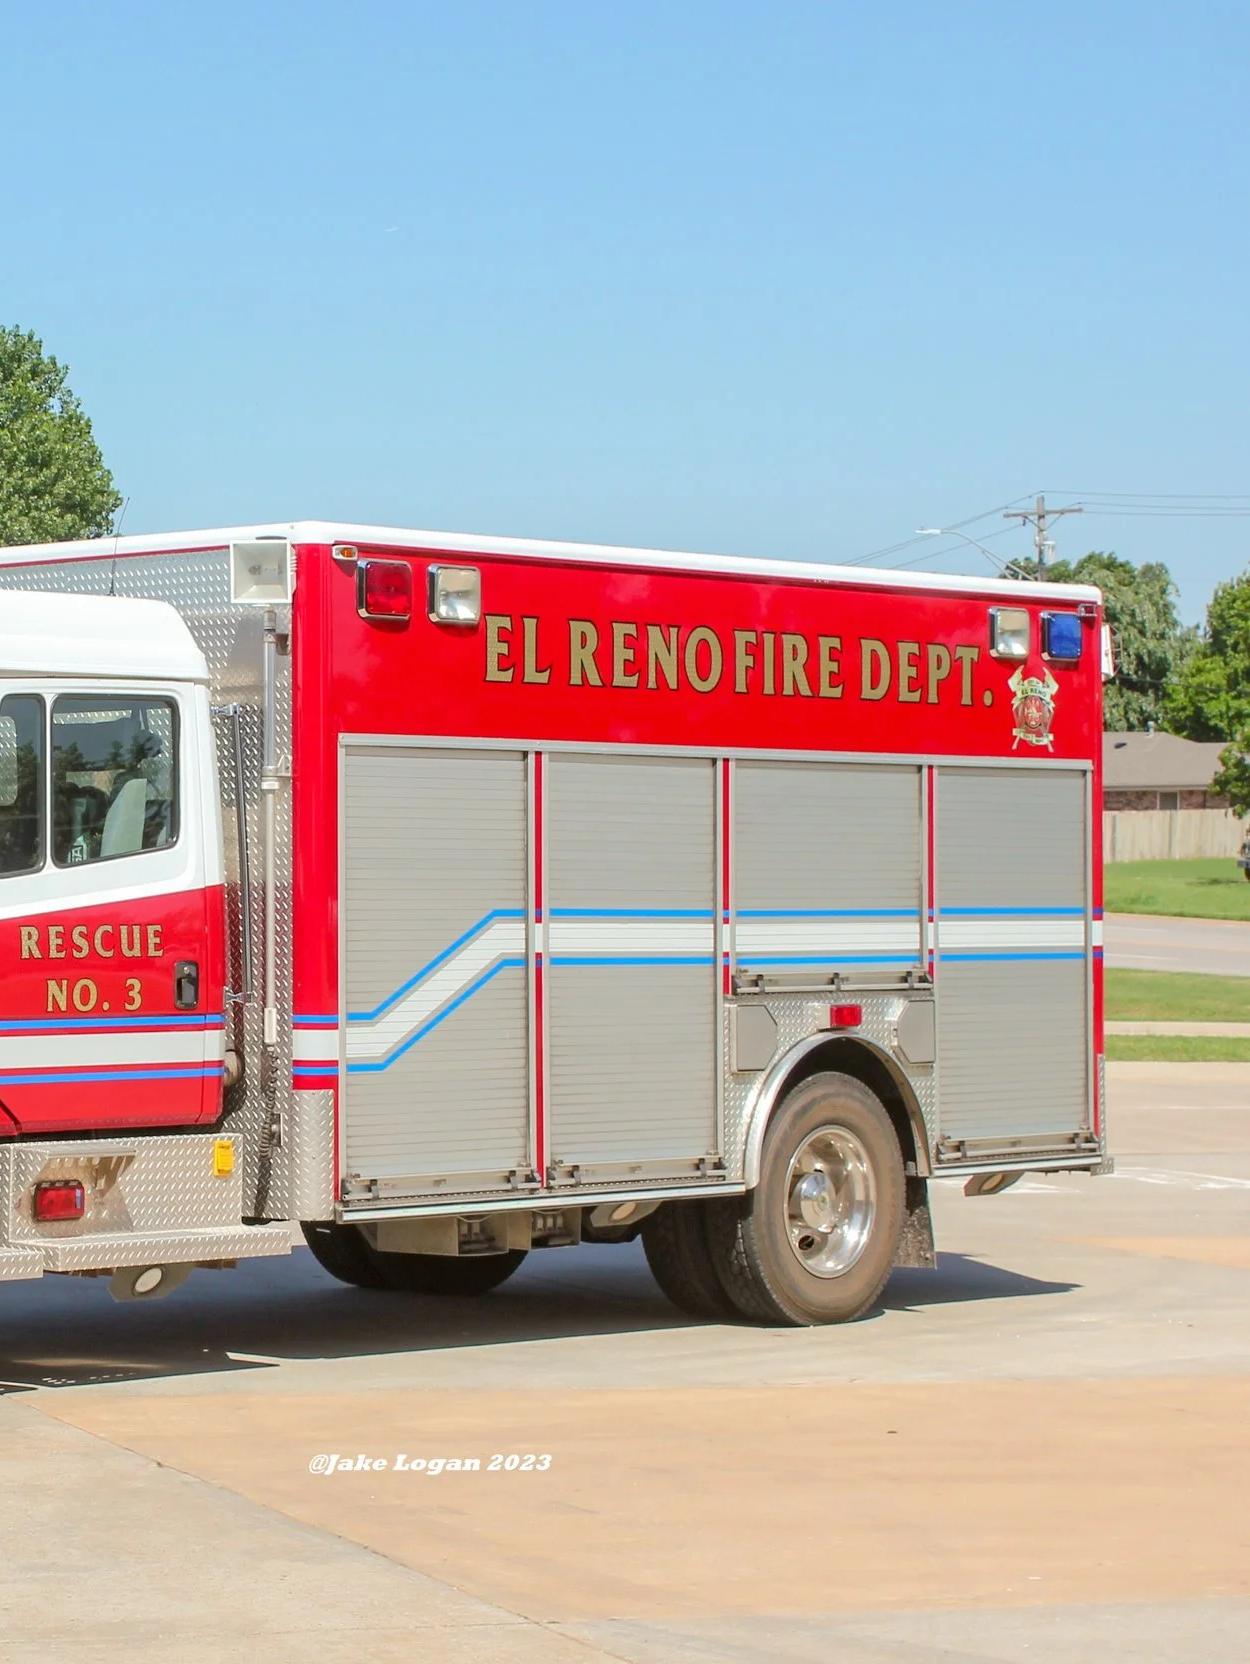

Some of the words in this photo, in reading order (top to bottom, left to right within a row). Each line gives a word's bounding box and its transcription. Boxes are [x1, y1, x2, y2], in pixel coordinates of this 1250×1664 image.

[484, 613, 551, 684] EL
[567, 617, 724, 694] RENO
[733, 628, 846, 700] FIRE
[858, 636, 995, 708] DEPT.
[18, 923, 165, 960] RESCUE
[45, 976, 111, 1013] NO.
[123, 976, 143, 1012] 3
